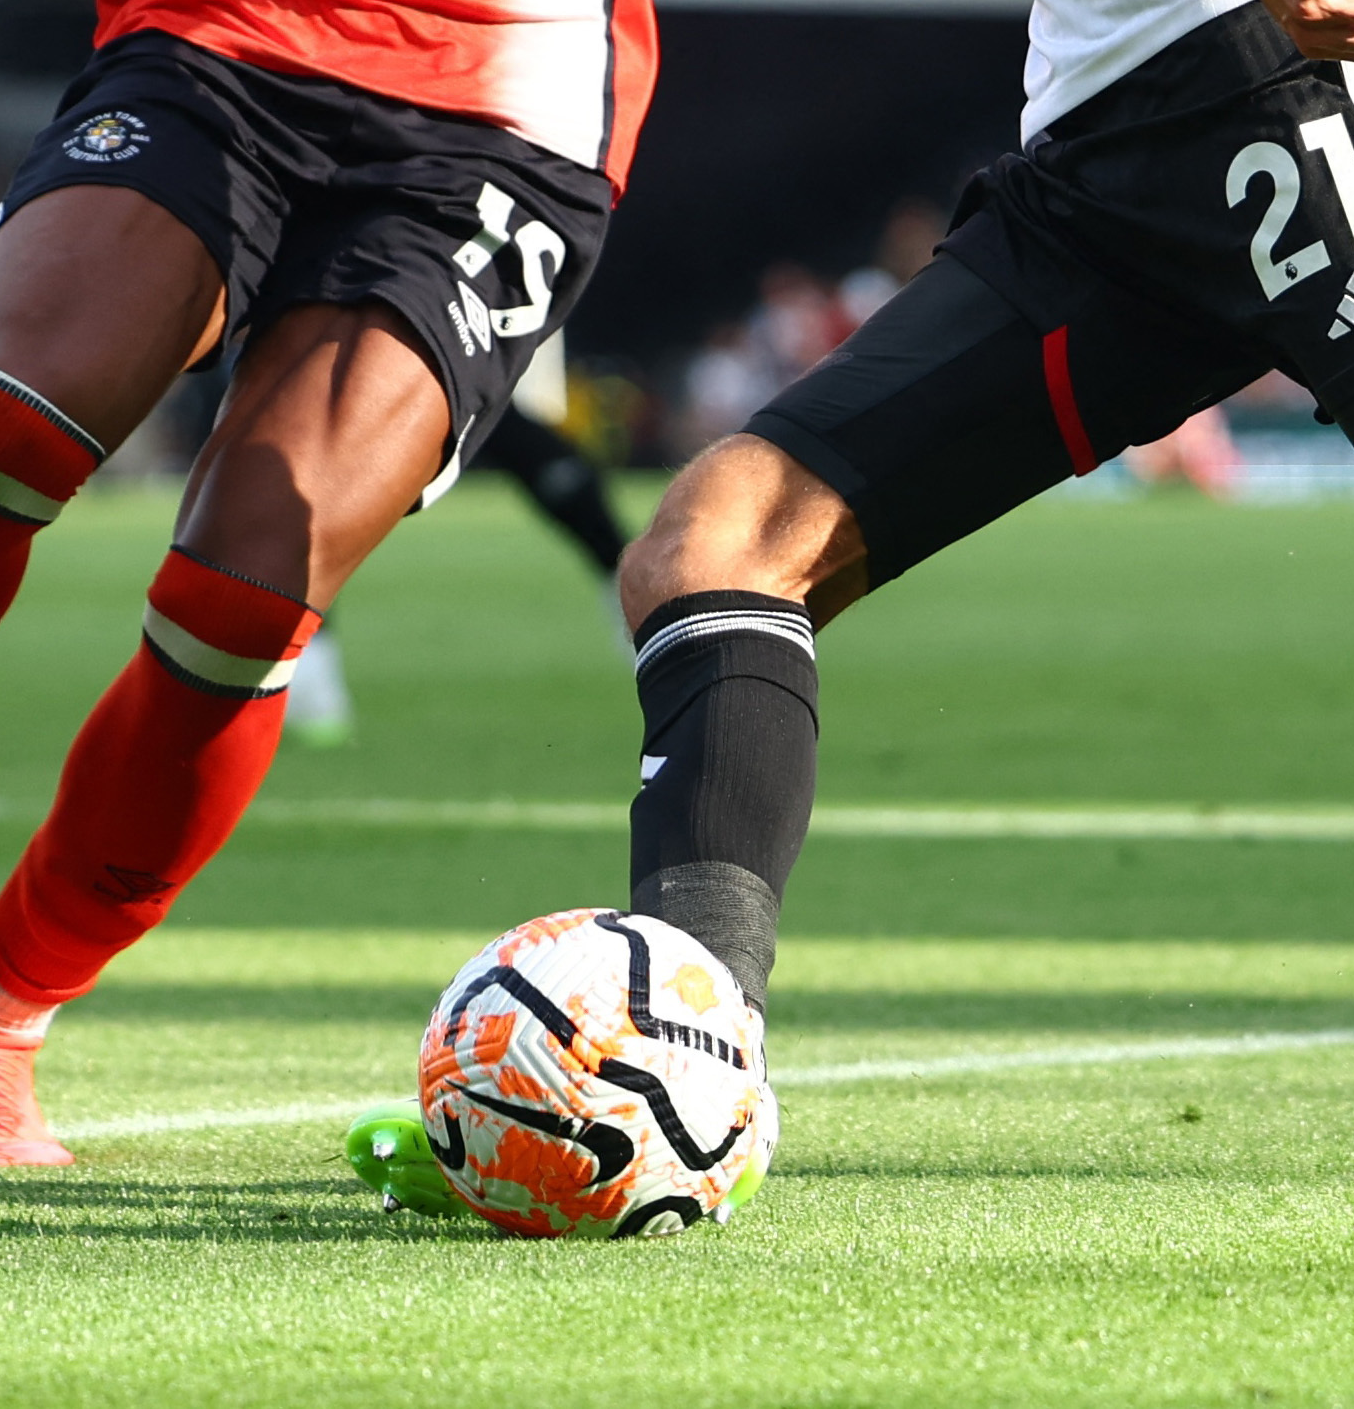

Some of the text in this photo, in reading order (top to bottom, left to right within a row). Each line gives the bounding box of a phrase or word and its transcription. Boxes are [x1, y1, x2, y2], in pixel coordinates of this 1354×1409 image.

[114, 111, 147, 129] TOWN
[112, 144, 141, 161] CLUB
[447, 300, 476, 358] umbro
